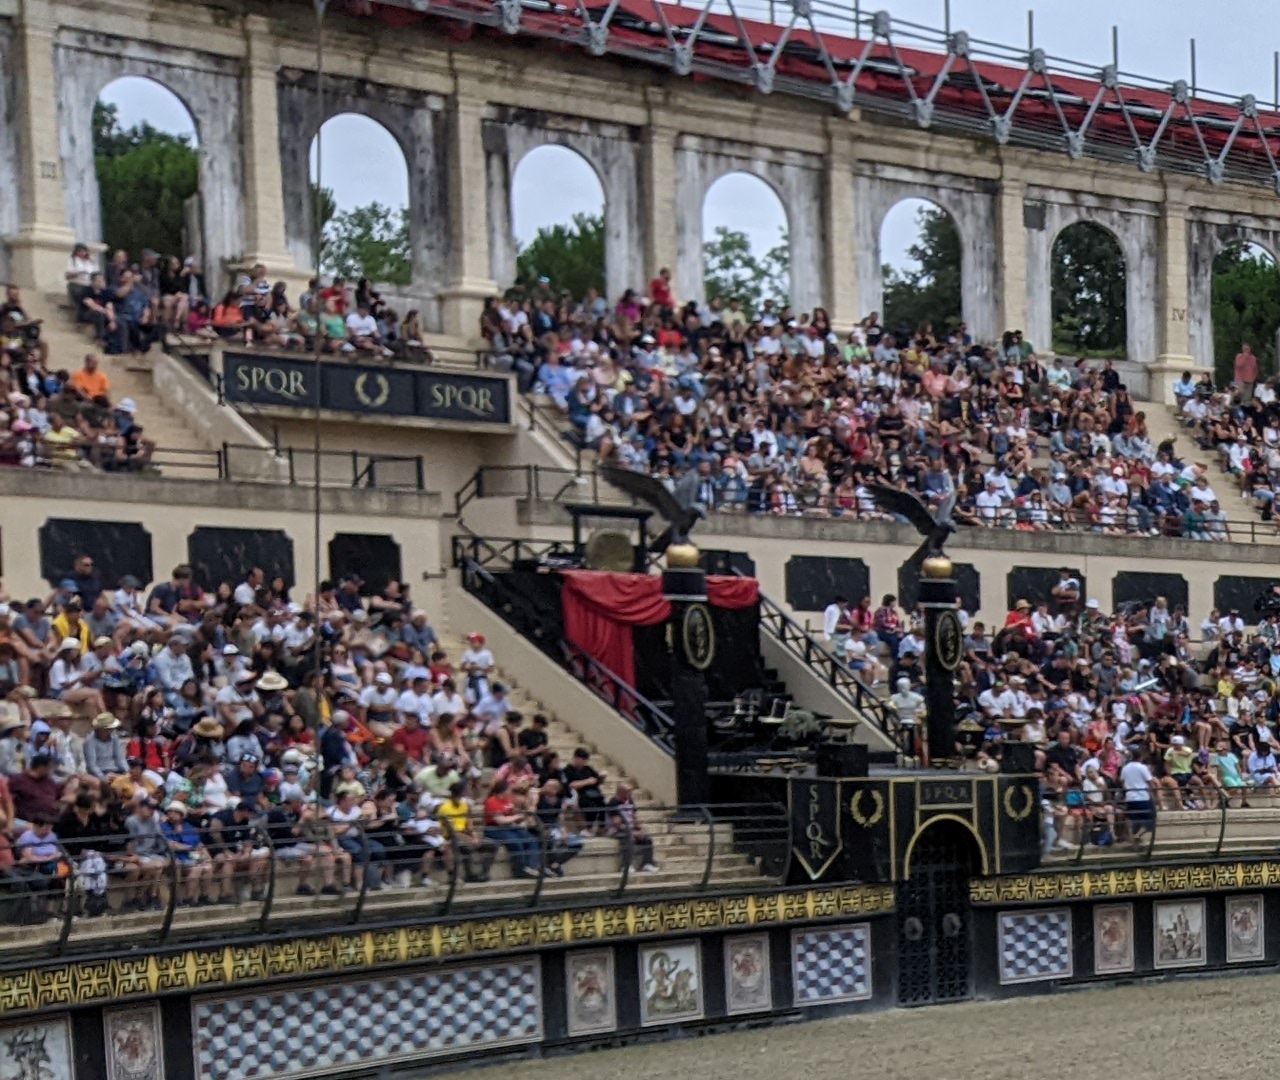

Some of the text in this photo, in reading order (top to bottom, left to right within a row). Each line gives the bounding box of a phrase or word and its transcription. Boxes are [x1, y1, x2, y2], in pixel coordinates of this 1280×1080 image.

[237, 365, 307, 400] SPQR
[432, 384, 495, 416] SPQR
[806, 785, 829, 859] SPQR
